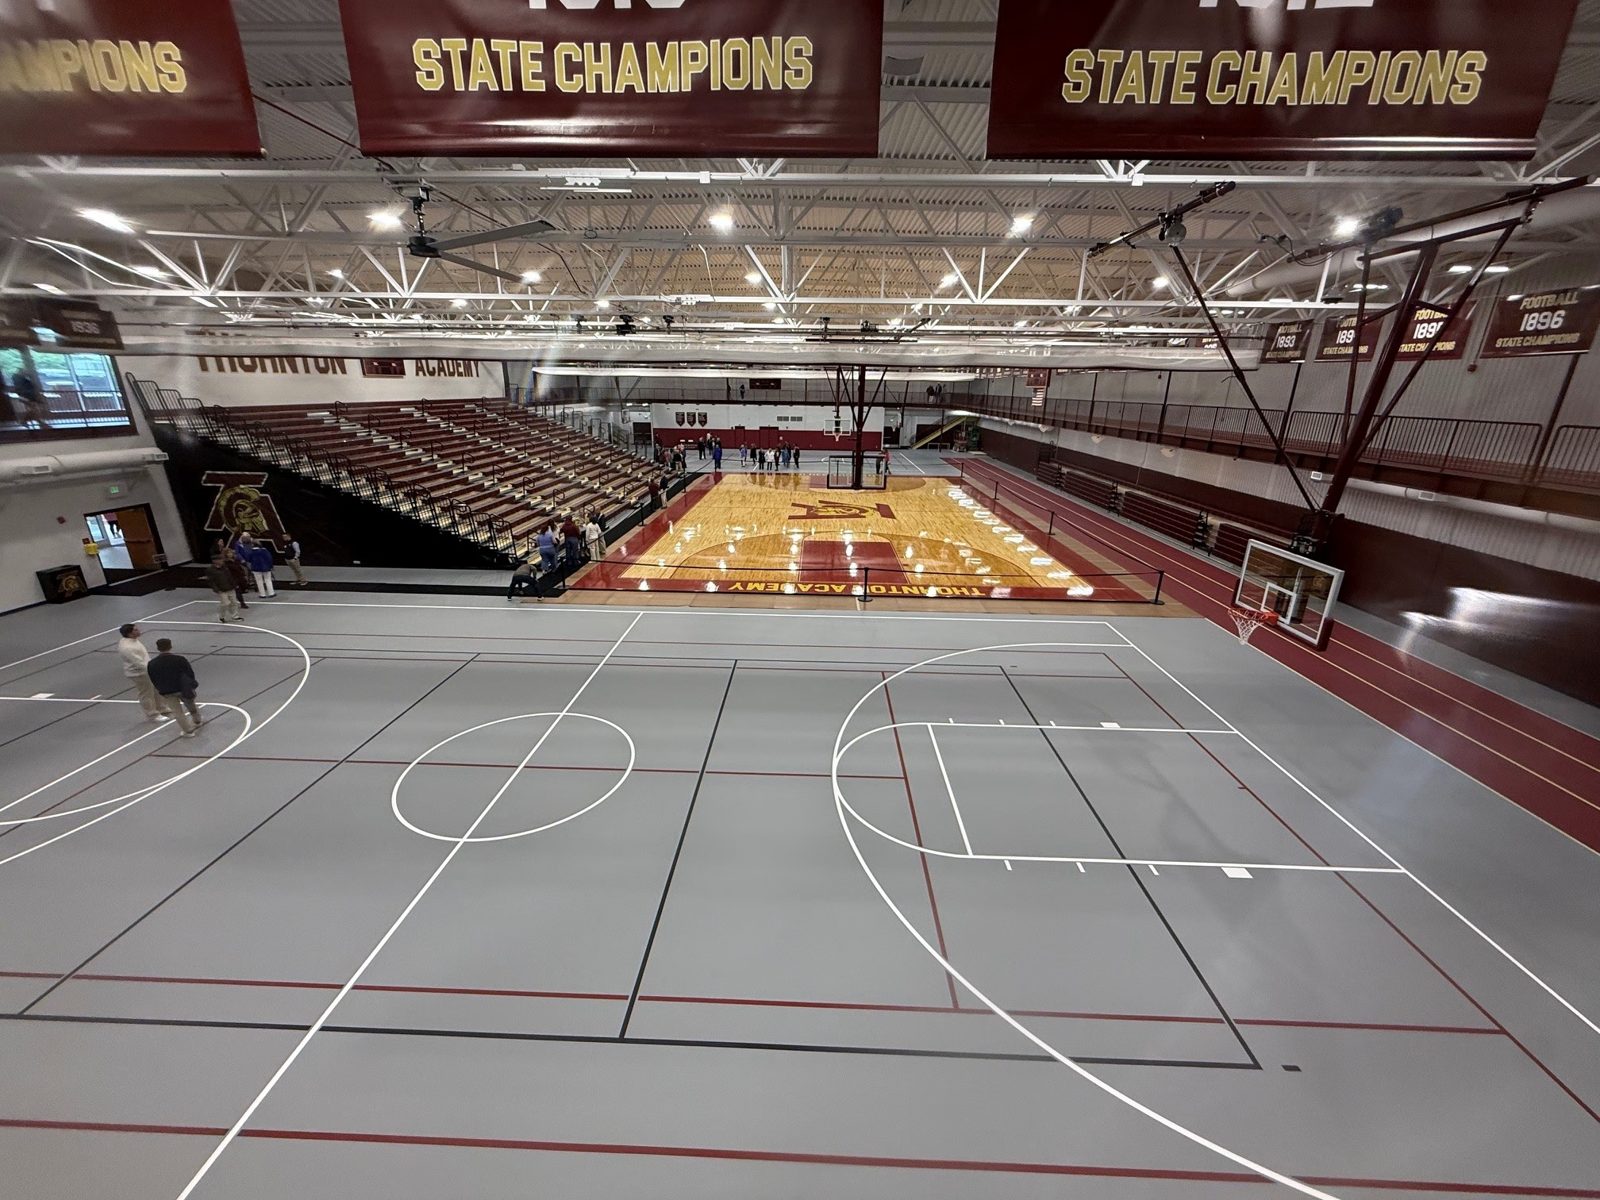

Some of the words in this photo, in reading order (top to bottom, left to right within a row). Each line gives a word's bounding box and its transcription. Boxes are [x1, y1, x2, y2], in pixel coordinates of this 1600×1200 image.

[412, 38, 546, 91] STATE
[553, 36, 813, 93] CHAMPIONS
[1061, 48, 1202, 104] STATE
[1205, 50, 1488, 105] CHAMPIONS
[1520, 292, 1578, 310] FOOTBALL
[1520, 310, 1566, 332] 1896
[1336, 330, 1356, 344] 189
[1496, 336, 1523, 347] STATE
[1522, 333, 1580, 346] CHAMPIONS
[1338, 346, 1368, 354] CHAMONS
[1415, 341, 1456, 352] CHPIONS
[852, 584, 986, 597] THONTO
